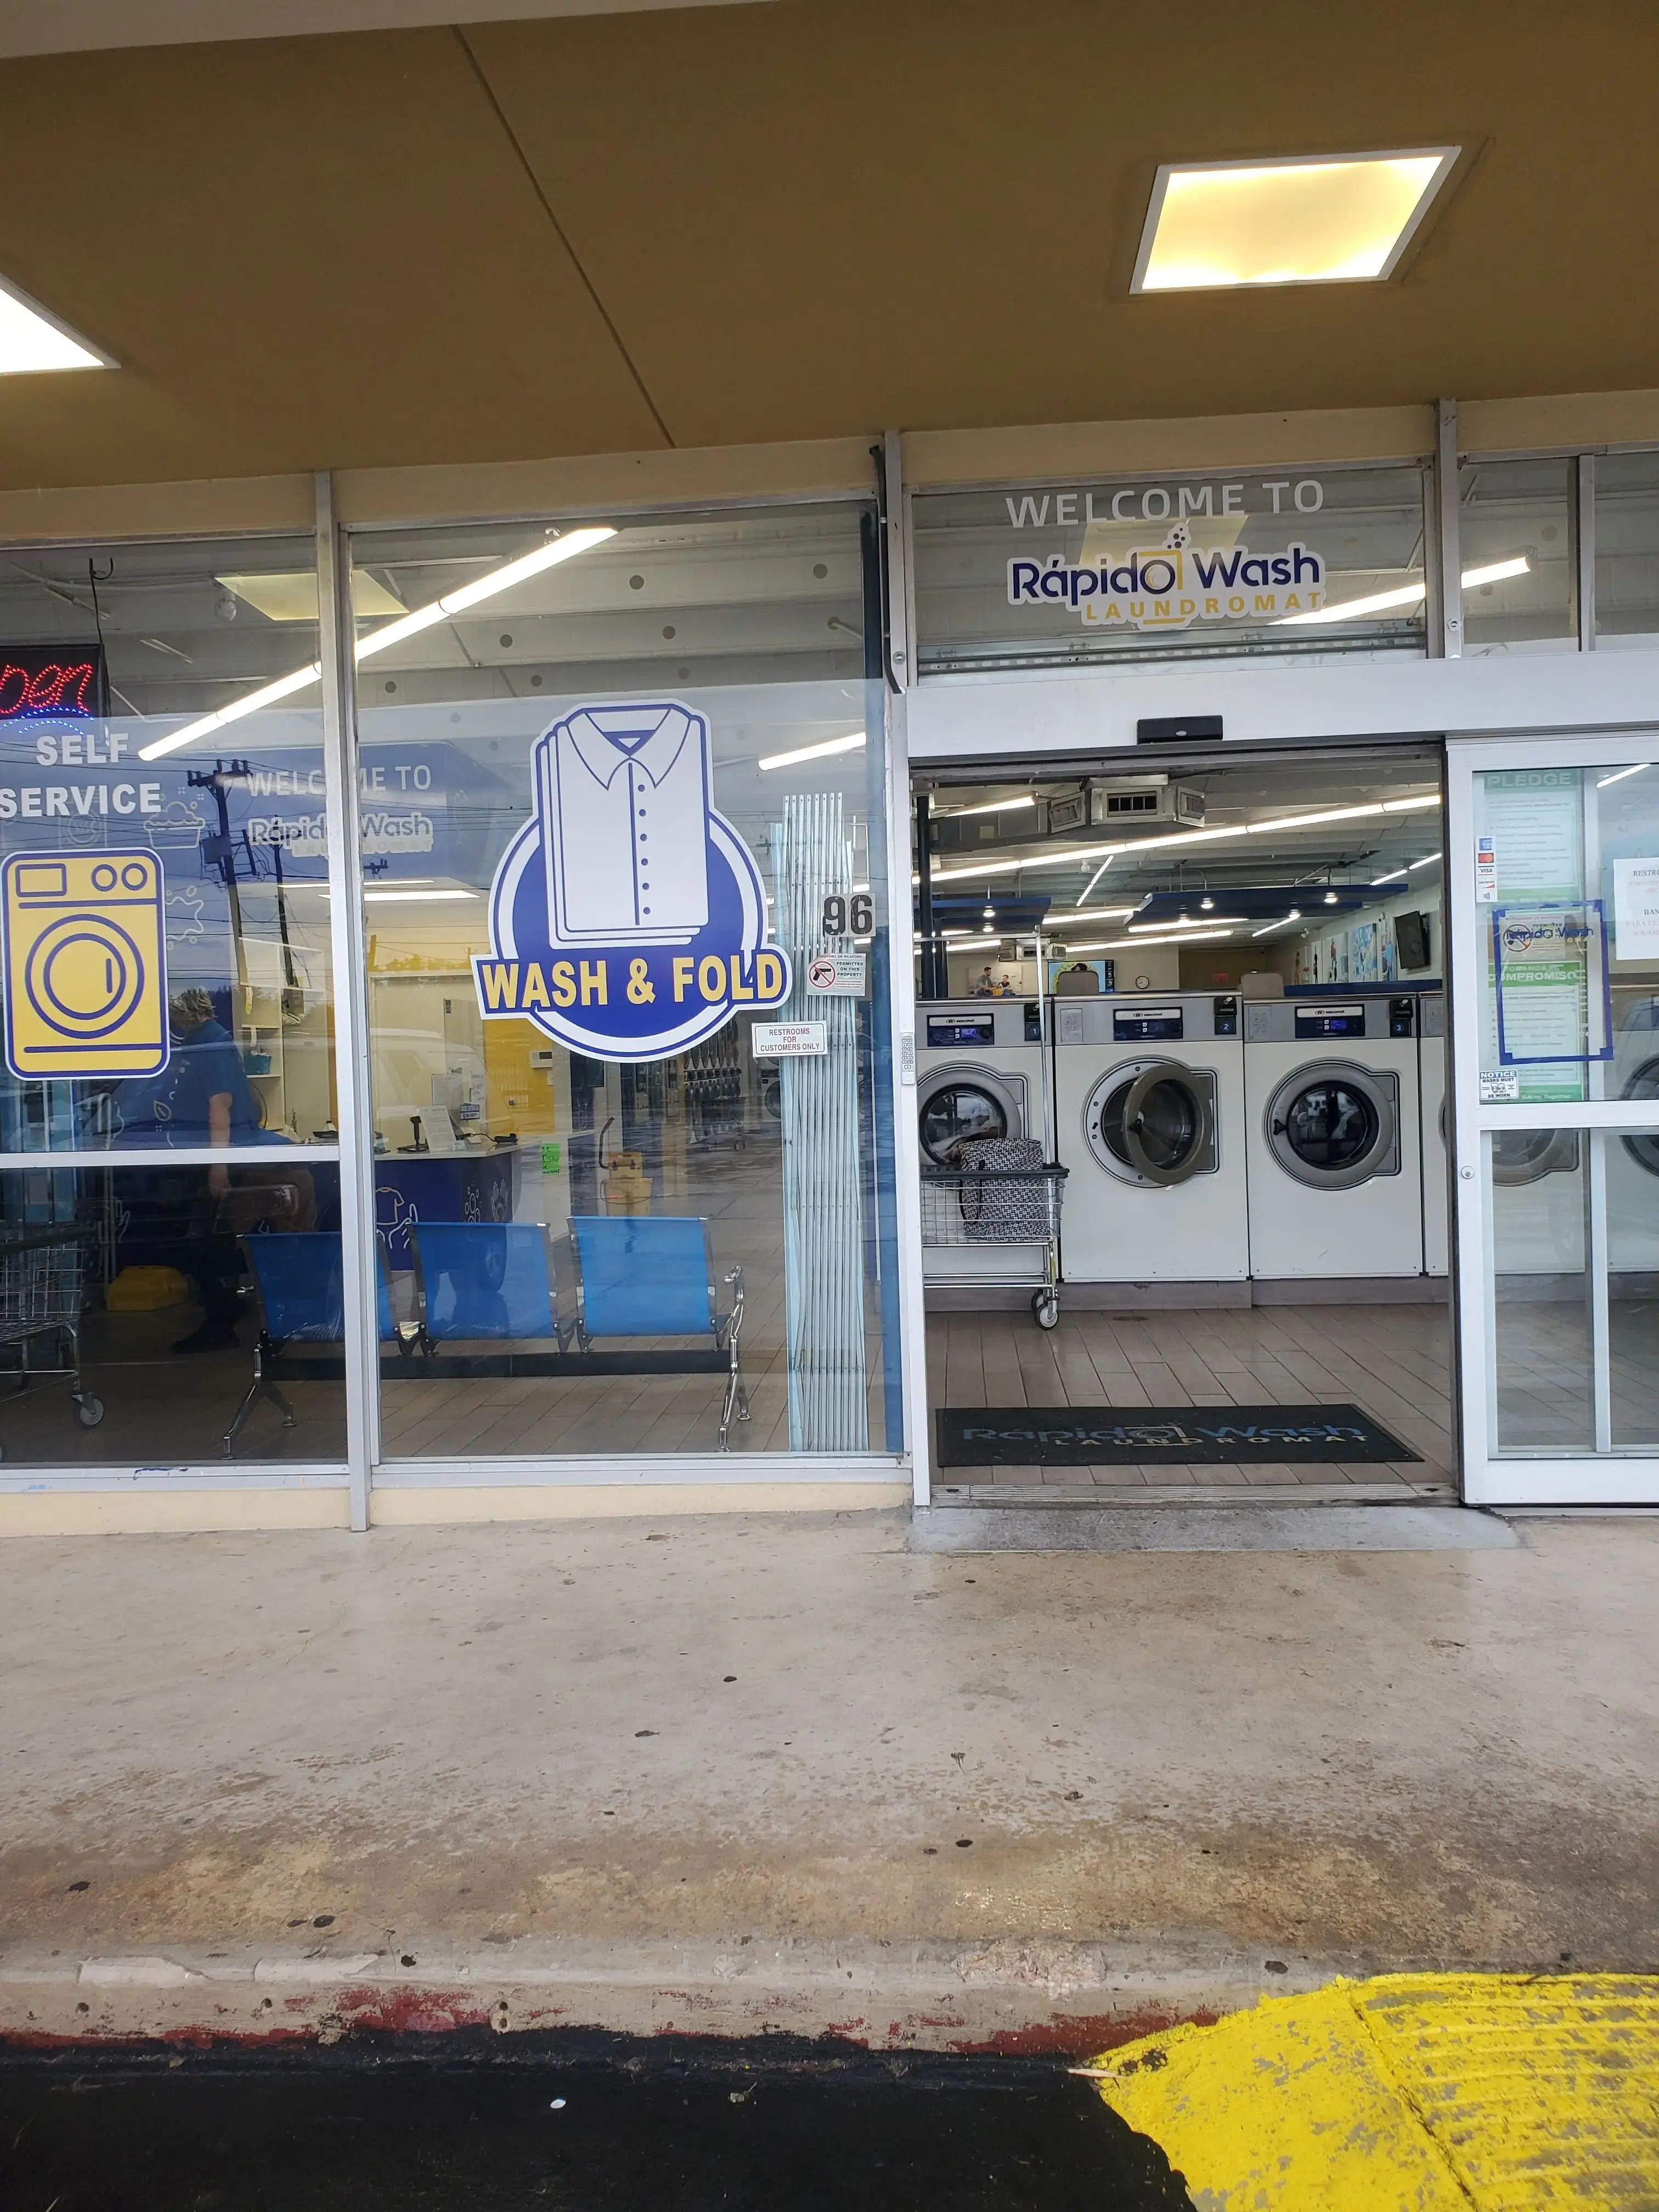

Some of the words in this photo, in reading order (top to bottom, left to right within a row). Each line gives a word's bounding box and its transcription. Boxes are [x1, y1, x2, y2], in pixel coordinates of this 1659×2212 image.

[1006, 484, 1245, 528] WELCOME
[1262, 480, 1323, 514] TO
[1013, 552, 1176, 606] Rápido
[1193, 548, 1319, 588] Wash
[1086, 592, 1320, 620] LAUNDROMAT
[36, 732, 128, 765] SELF
[247, 767, 385, 797] WELCE
[396, 765, 431, 790] TO
[1487, 772, 1571, 788] PLEDGE
[0, 783, 161, 818] SERVICE
[361, 815, 430, 837] Wash
[823, 895, 872, 936] 96
[482, 961, 607, 1008] WASH
[627, 958, 656, 1003] &
[673, 954, 782, 1002] FOLD
[769, 1028, 810, 1036] RESTROOMS
[1054, 1436, 1367, 1445] LAUNDROMAT
[1195, 1425, 1363, 1438] Wash
